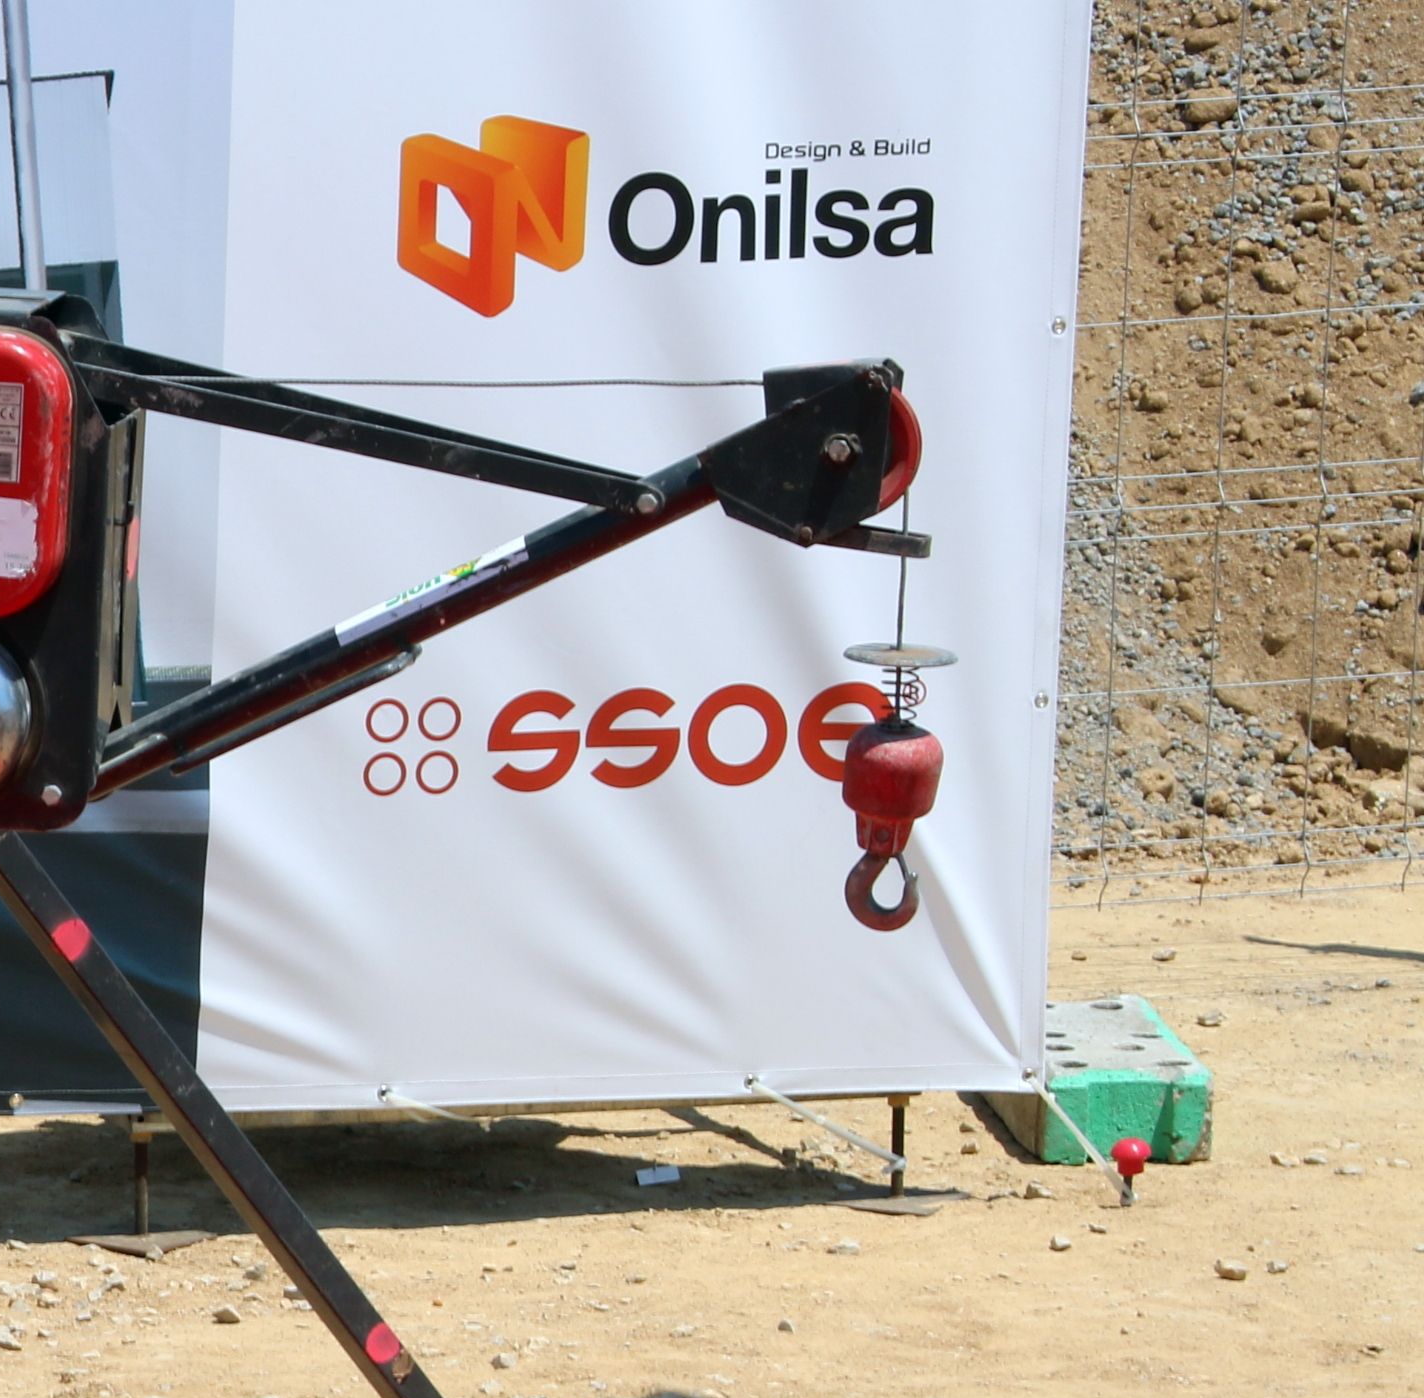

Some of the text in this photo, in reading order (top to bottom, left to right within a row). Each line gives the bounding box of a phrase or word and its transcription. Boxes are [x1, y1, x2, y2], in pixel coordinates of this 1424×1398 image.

[765, 138, 931, 163] Design & Build
[608, 168, 934, 267] Onilsa
